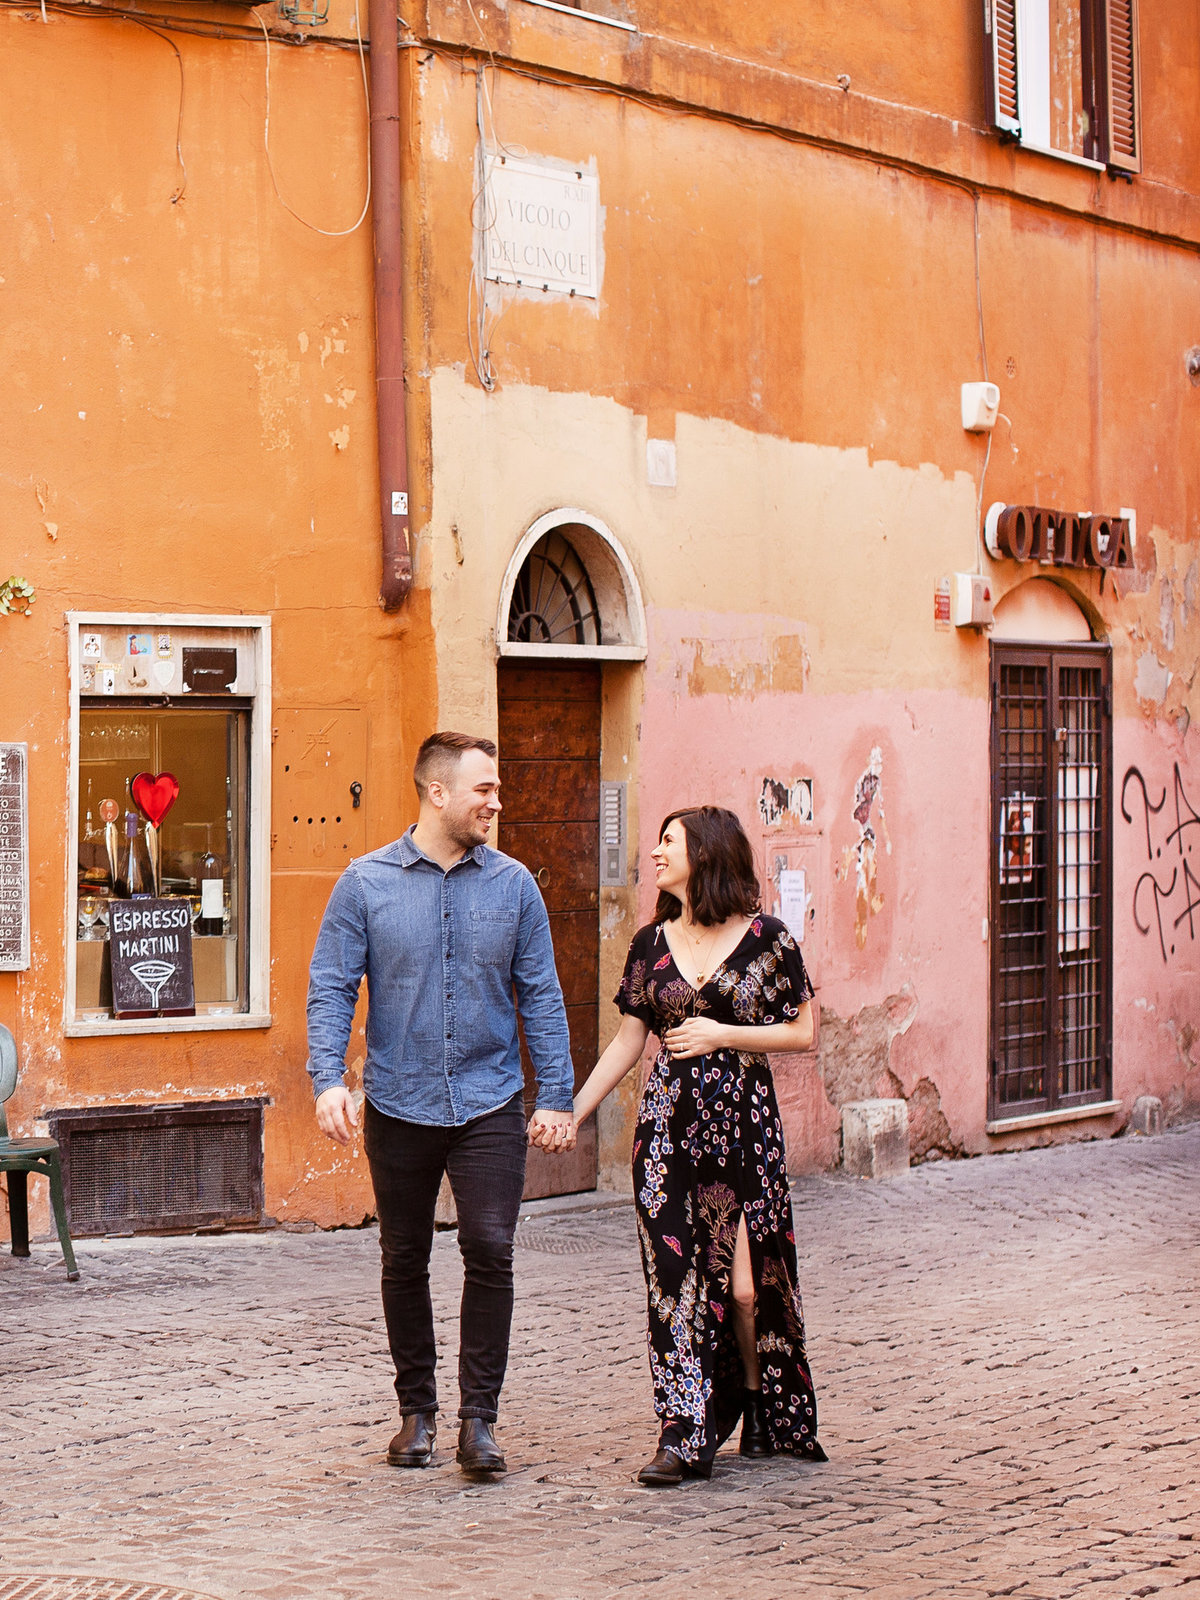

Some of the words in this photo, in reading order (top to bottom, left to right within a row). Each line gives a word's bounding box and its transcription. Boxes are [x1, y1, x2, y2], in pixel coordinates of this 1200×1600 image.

[507, 199, 571, 231] VICOLO
[524, 245, 588, 277] CINQUE
[998, 504, 1136, 569] OTTICA
[113, 909, 188, 933] ESPRESSO
[119, 934, 179, 958] MARTINI
